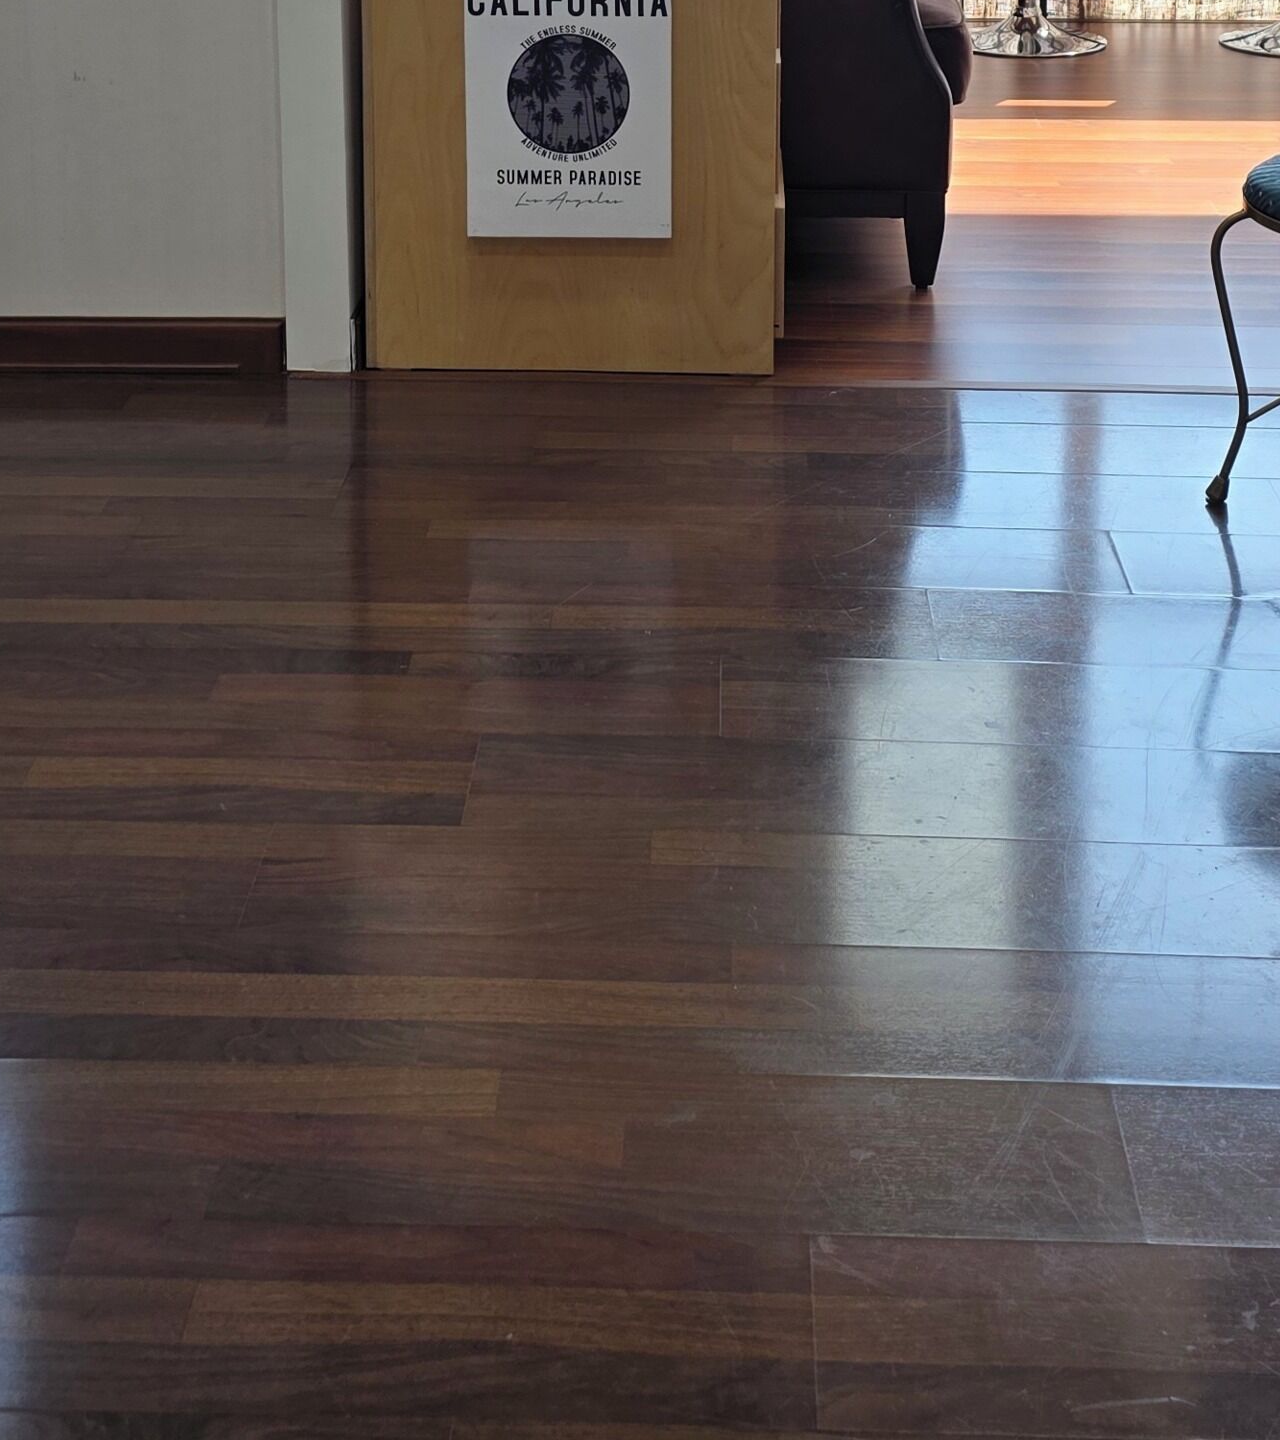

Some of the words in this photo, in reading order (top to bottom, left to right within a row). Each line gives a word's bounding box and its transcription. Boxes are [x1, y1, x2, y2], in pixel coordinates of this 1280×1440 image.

[520, 35, 537, 49] THE
[537, 24, 577, 39] ENDLESS
[579, 26, 617, 50] SUMMER
[521, 137, 569, 162] ADVENTURE
[573, 138, 618, 162] UNLIMITED
[496, 169, 563, 185] SUMMER
[569, 170, 642, 186] PARADISE
[515, 191, 544, 207] Los
[544, 191, 624, 212] Angeles
